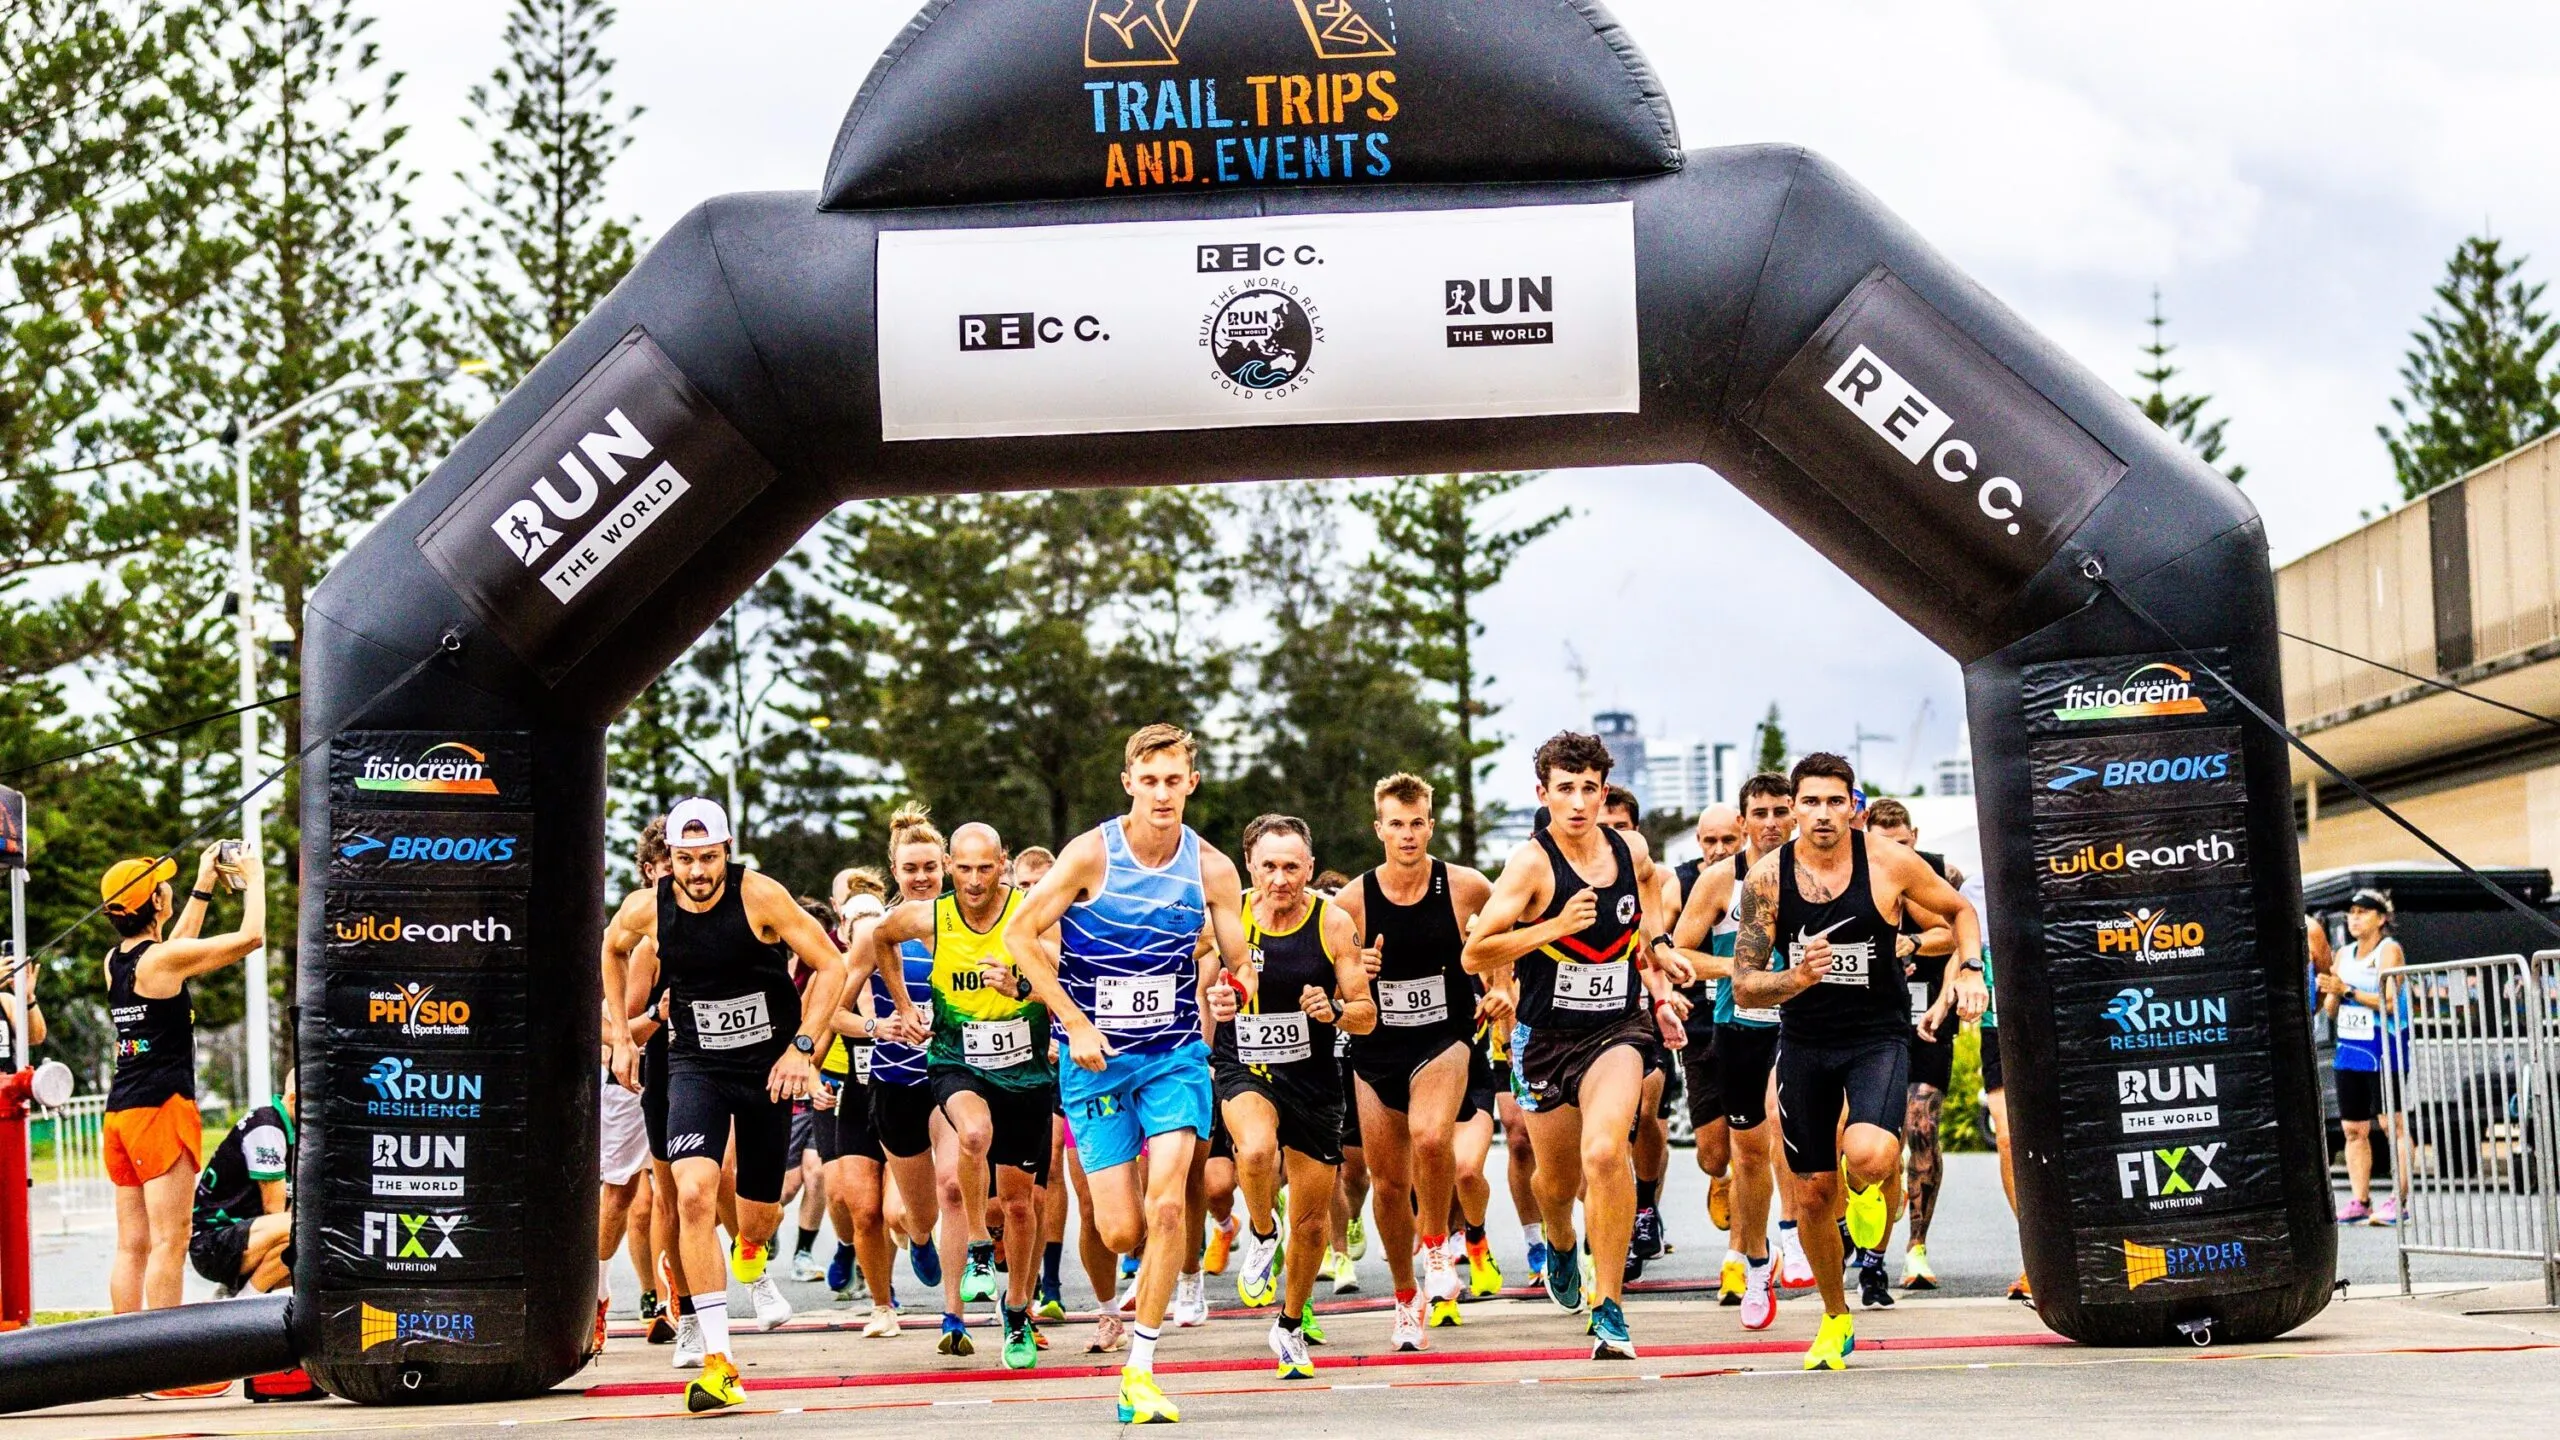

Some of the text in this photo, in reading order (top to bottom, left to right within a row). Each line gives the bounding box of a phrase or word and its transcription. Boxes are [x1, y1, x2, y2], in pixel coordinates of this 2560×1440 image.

[1445, 276, 1553, 315] RUN
[1199, 277, 1325, 346] RUN THE WORLD RELAY
[1228, 310, 1268, 326] RUN
[1453, 328, 1547, 342] THE WORLD
[1211, 366, 1315, 400] GOLD COAST
[490, 406, 655, 567] RUN
[556, 478, 673, 587] THE WORLD
[2064, 681, 2189, 710] fisiocrem
[363, 755, 483, 782] fisiocrem
[2102, 753, 2229, 787] BROOKS
[388, 836, 517, 861] BROOKS
[2096, 919, 2134, 930] Gold Coast
[2135, 946, 2205, 963] & Sports Health
[369, 991, 404, 1000] Gold Coast
[1589, 975, 1613, 997] 54
[1132, 989, 1159, 1013] 85
[1407, 989, 1431, 1009] 98
[718, 1005, 757, 1031] 267
[2148, 997, 2227, 1029] RUN
[401, 1023, 469, 1036] & Sports Health
[992, 1031, 1014, 1051] 91
[1259, 1024, 1300, 1045] 239
[2110, 1027, 2228, 1050] RESILIENCE
[404, 1073, 482, 1100] RUN
[2117, 1063, 2217, 1105] RUN
[367, 1101, 481, 1118] RESILIENCE
[1085, 1092, 1127, 1120] FIXX
[2129, 1112, 2213, 1127] THE WORLD
[372, 1134, 465, 1168] RUN
[377, 1180, 458, 1191] THE WORLD
[2149, 1196, 2203, 1211] NUTRITION
[2166, 1241, 2245, 1265] SPYDER
[386, 1262, 437, 1272] NUTRITION
[2168, 1256, 2247, 1275] DISPLAYS
[398, 1313, 475, 1329] SPYDER
